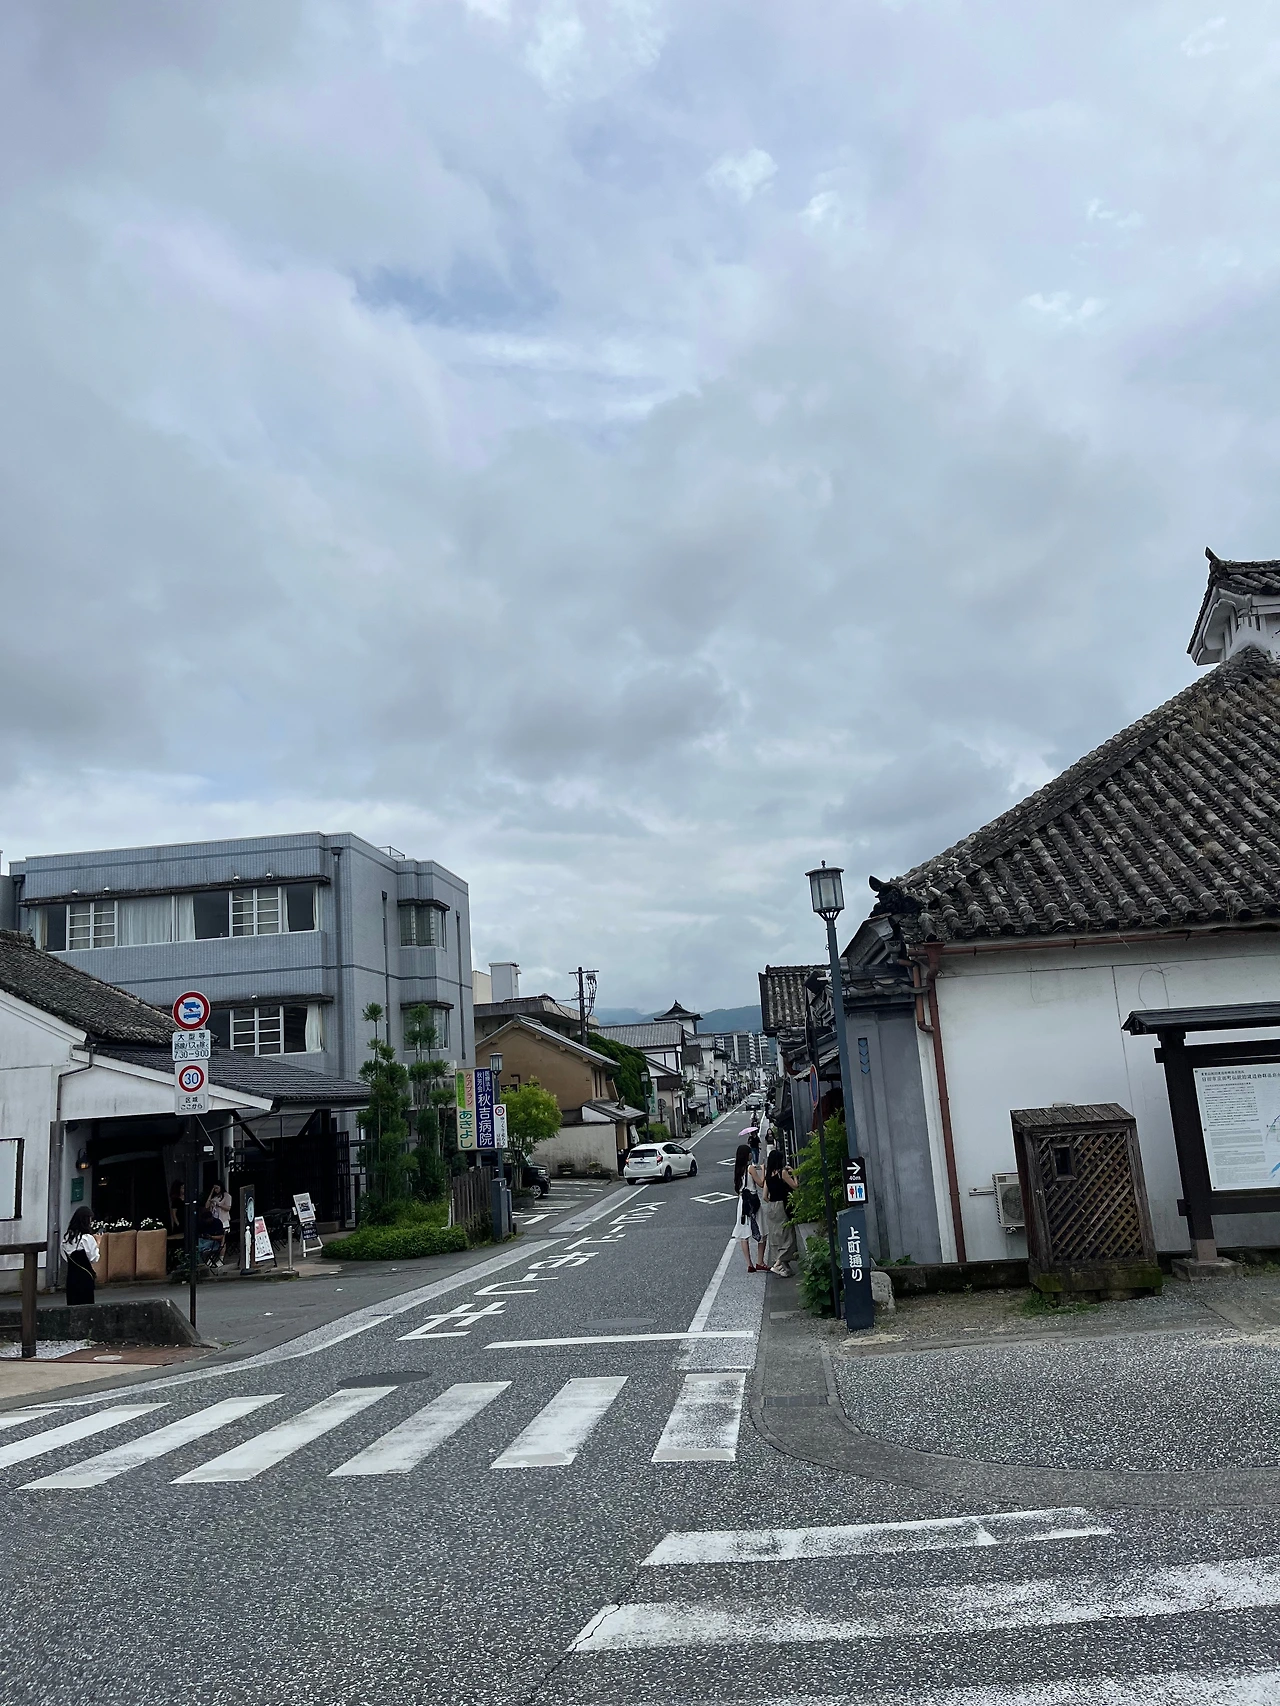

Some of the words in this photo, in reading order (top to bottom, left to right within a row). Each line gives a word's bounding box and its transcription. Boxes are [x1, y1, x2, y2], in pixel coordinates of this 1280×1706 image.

[184, 1072, 199, 1085] 30
[459, 1110, 473, 1149] あきよし
[477, 1093, 493, 1146] 秋吉病院
[396, 1201, 668, 1341] スピードおとせ
[847, 1226, 863, 1282] 上町通り
